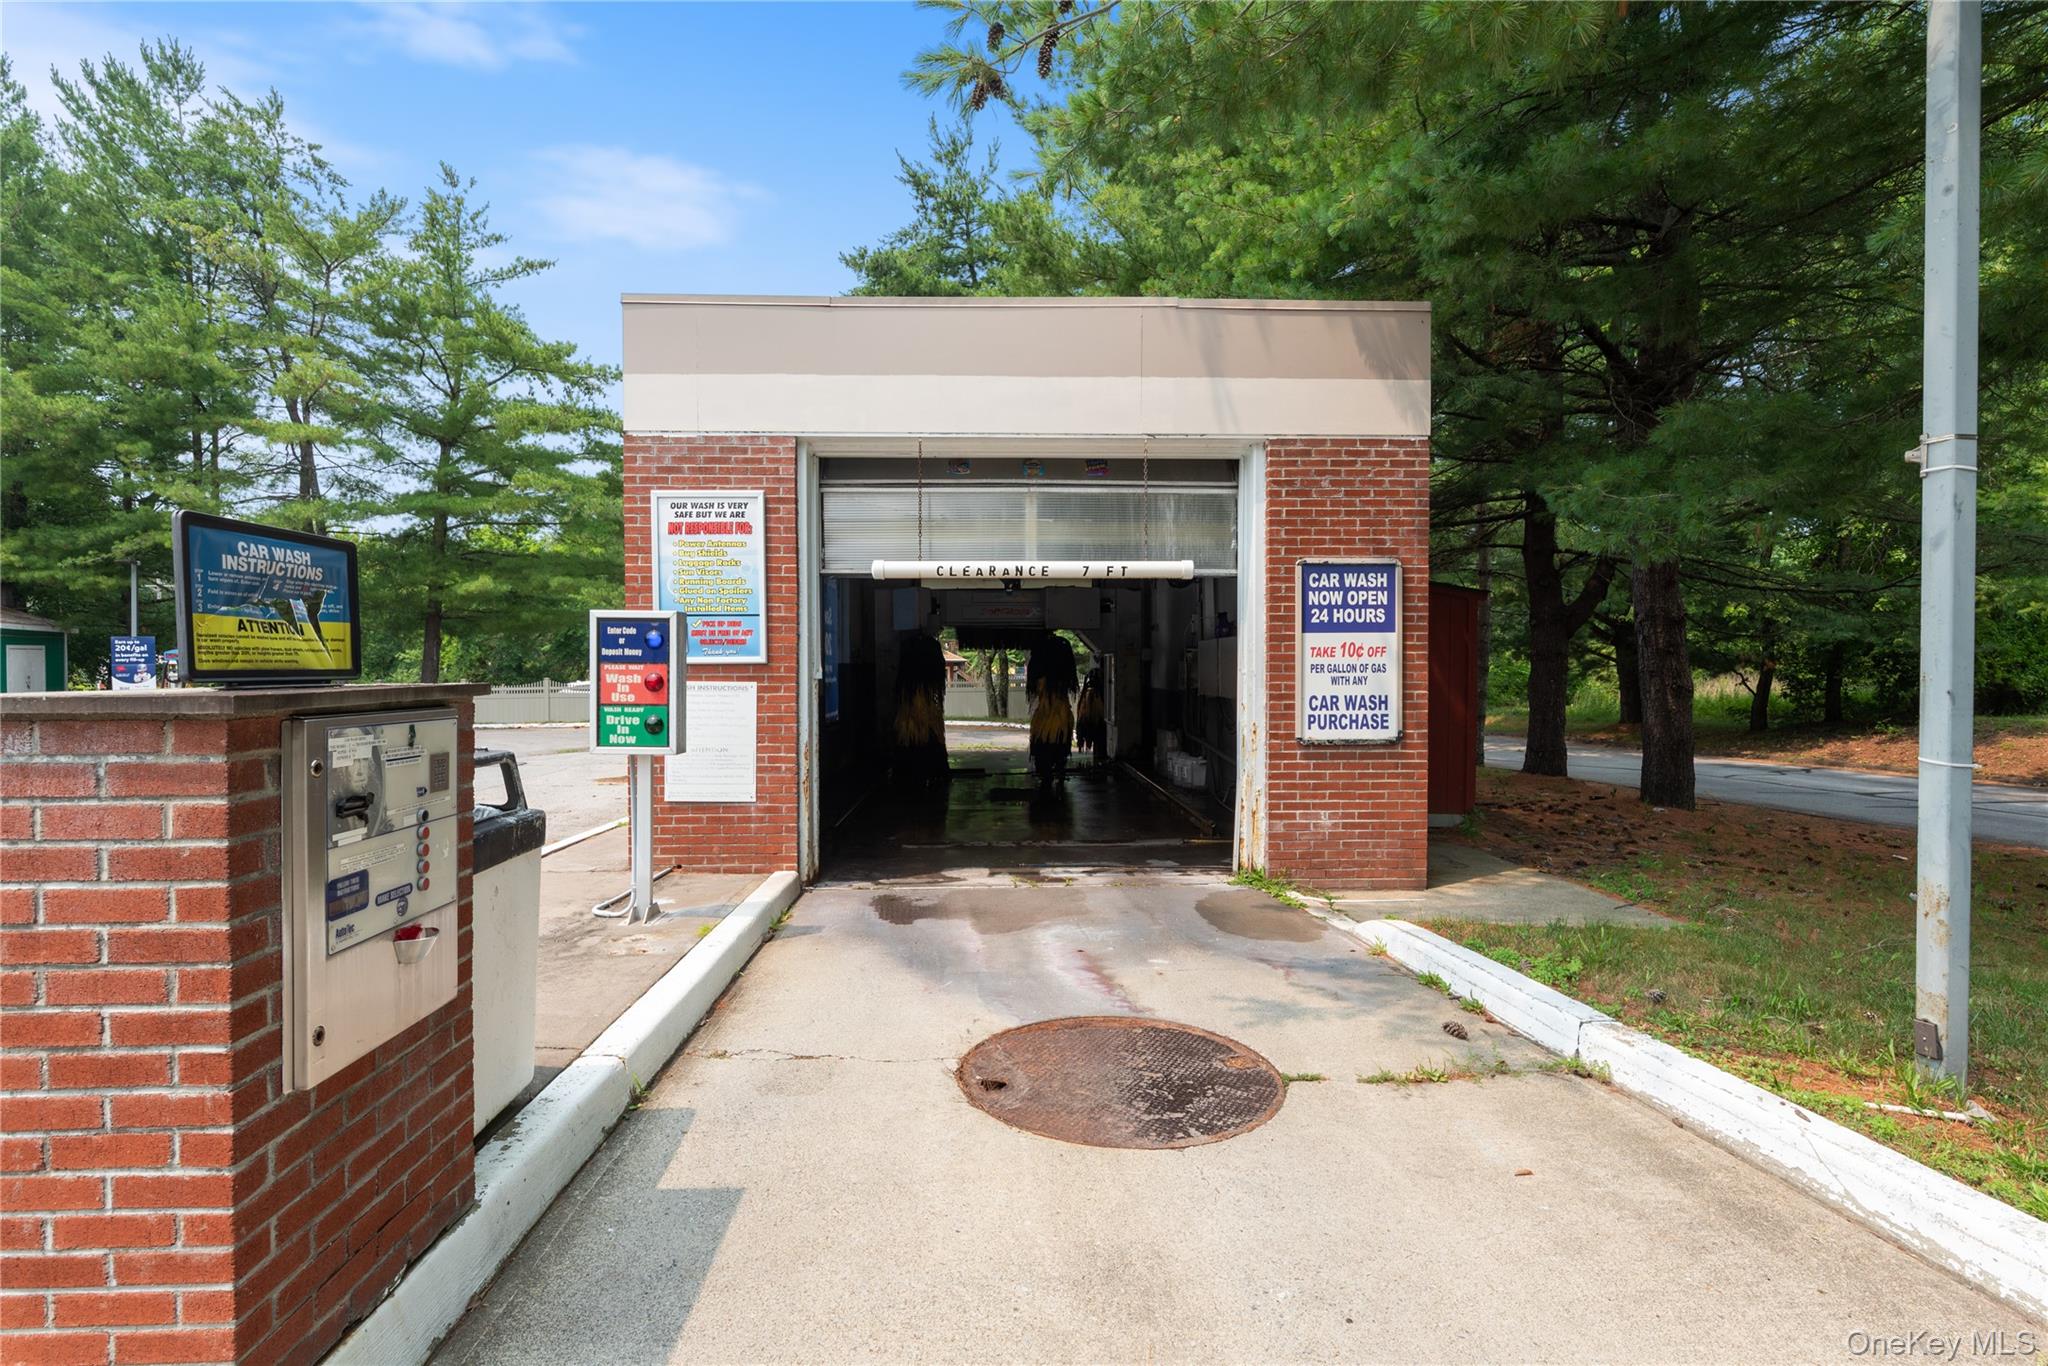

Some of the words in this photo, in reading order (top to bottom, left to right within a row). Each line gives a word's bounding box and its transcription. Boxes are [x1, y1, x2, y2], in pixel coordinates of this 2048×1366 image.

[670, 502, 688, 510] OUR
[690, 502, 715, 510] WASH
[717, 502, 725, 510] IS
[727, 502, 748, 510] VERY
[674, 511, 693, 519] SAFE
[696, 511, 712, 519] BUT
[714, 511, 727, 519] WE
[729, 511, 746, 519] ARE
[668, 522, 684, 535] NOT
[684, 522, 734, 535] RESPONSIBLE
[237, 541, 270, 560] CAR
[272, 546, 311, 566] WASH
[222, 554, 324, 582] INSTRUCTIONS
[936, 566, 1050, 577] CLEARANCE
[1082, 566, 1090, 577] 7
[1106, 566, 1129, 577] FT
[1308, 572, 1340, 588] CAR
[1344, 572, 1388, 588] WASH
[1308, 590, 1343, 606] NOW
[1347, 590, 1388, 606] OPEN
[1310, 608, 1330, 624] 24
[1333, 608, 1386, 624] HOURS
[607, 626, 622, 634] Enter
[622, 626, 637, 634] Code
[114, 644, 148, 652] 20¢/gal
[602, 648, 623, 656] Deposit
[624, 648, 642, 656] Money
[1310, 646, 1336, 658] TAKE
[1340, 642, 1364, 660] 10¢
[1367, 646, 1387, 658] OFF
[1310, 664, 1325, 674] PER
[1326, 664, 1357, 674] GALLON
[1359, 664, 1369, 674] OF
[1371, 664, 1387, 674] GAS
[605, 673, 642, 684] Wash
[1330, 676, 1350, 686] WITH
[1352, 676, 1368, 686] ANY
[616, 684, 630, 693] In
[610, 693, 636, 702] Use
[1308, 694, 1340, 712] CAR
[1344, 694, 1388, 712] WASH
[606, 714, 640, 725] Drive
[1307, 714, 1390, 730] PURCHASE
[616, 725, 630, 734] In
[609, 734, 636, 744] Now
